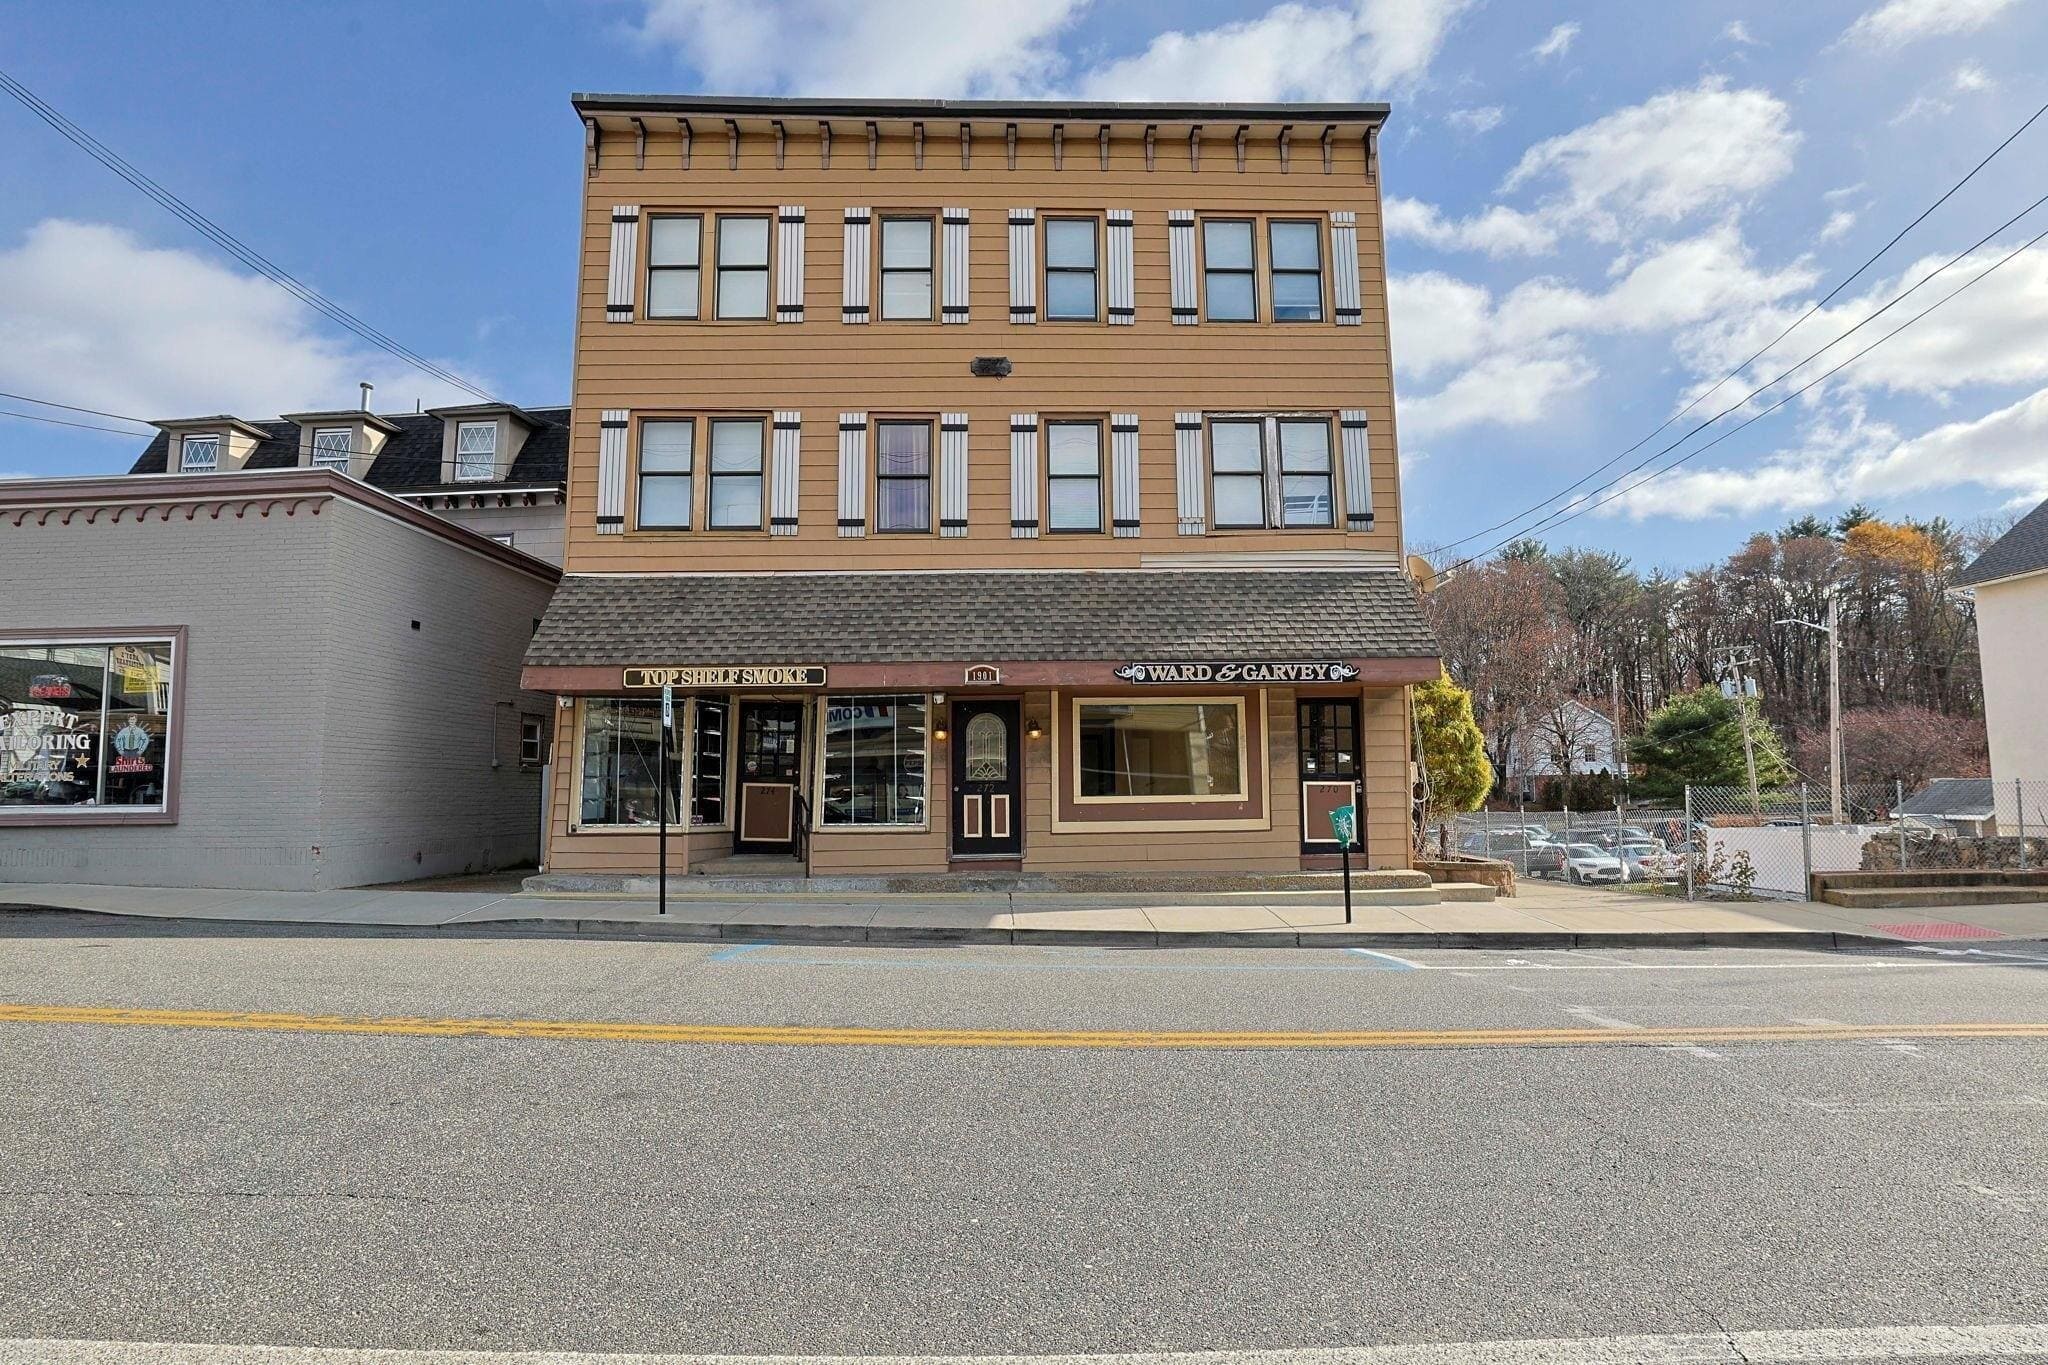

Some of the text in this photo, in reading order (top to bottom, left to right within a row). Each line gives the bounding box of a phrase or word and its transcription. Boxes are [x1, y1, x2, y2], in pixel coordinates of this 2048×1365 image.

[641, 668, 808, 686] TOP SHELF SMOKE
[972, 671, 992, 681] 1901
[1147, 663, 1328, 682] WARD & GARVEY
[0, 709, 79, 730] EXPERT
[109, 764, 154, 773] LAUNDERED
[977, 783, 995, 793] 272
[1320, 785, 1339, 794] 270
